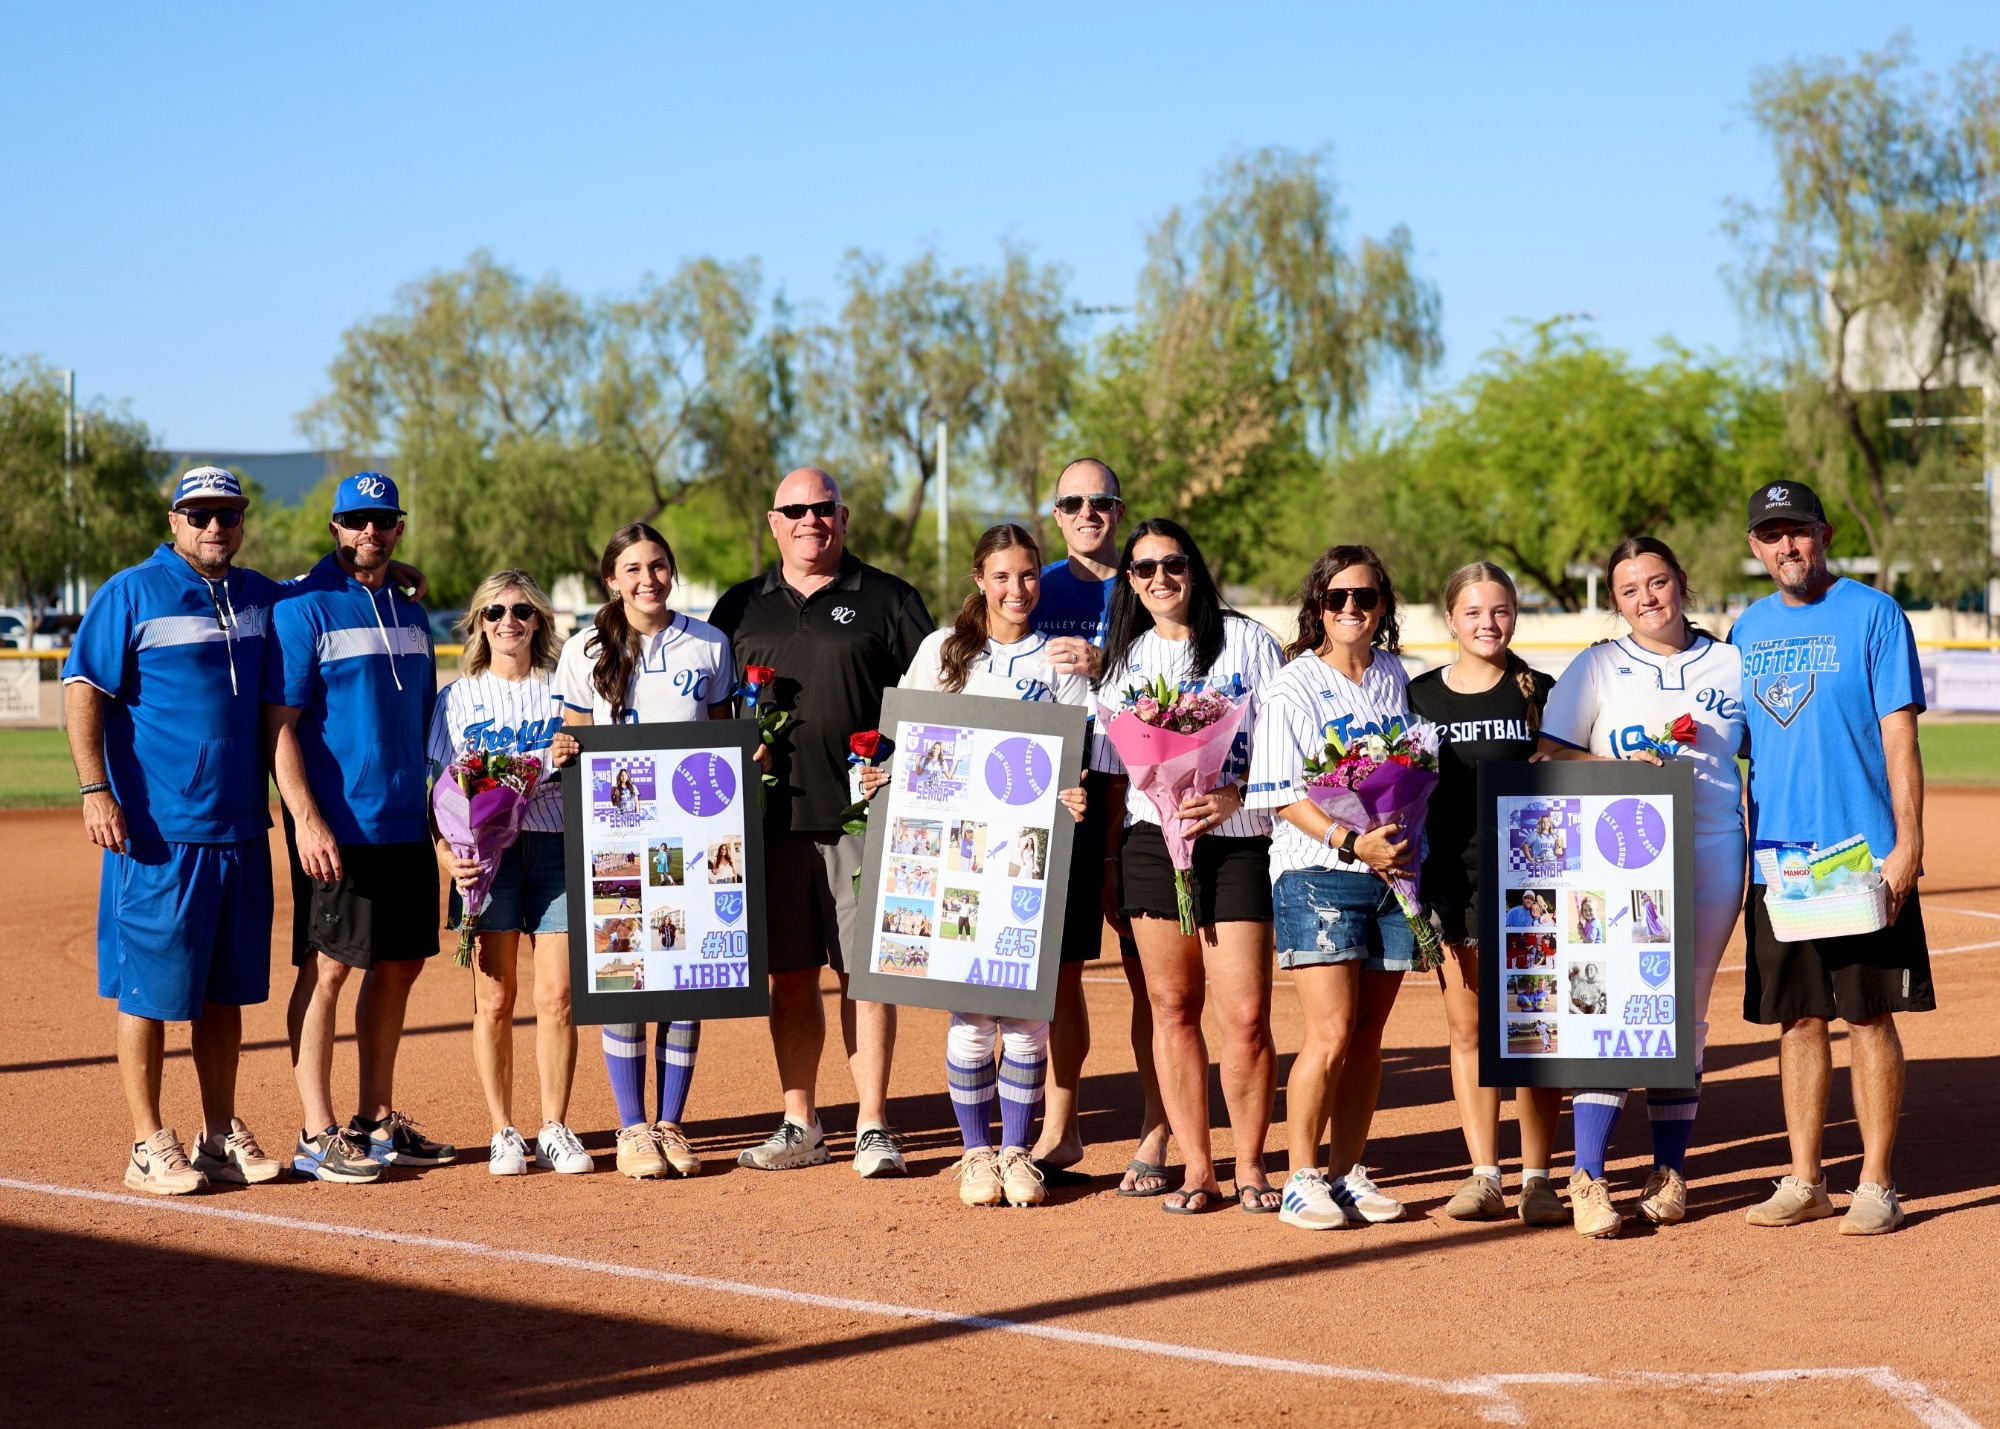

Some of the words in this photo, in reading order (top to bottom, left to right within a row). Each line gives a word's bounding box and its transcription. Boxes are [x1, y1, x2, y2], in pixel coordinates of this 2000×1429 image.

[357, 477, 385, 498] VC
[1765, 501, 1791, 509] SOFTBALL
[831, 606, 856, 624] VC
[1038, 621, 1076, 629] VALLEY
[1752, 640, 1784, 652] VALLEY
[1784, 635, 1835, 647] CHRISTIAN
[1743, 646, 1840, 680] SOFTBALL
[673, 669, 709, 701] VC
[1696, 688, 1737, 719] VC
[1450, 719, 1532, 743] SOFTBALL
[991, 748, 1006, 762] ADDI
[1025, 740, 1036, 764] CLASS
[677, 765, 697, 787] LIBBY
[709, 753, 718, 777] CLASS
[1025, 767, 1033, 776] OF
[710, 779, 719, 788] OF
[917, 785, 949, 802] SENIOR
[610, 814, 641, 828] SENIOR
[1636, 800, 1646, 826] CLASS
[1601, 810, 1619, 831] TAYA
[1616, 831, 1626, 868] CLAUSEN
[1638, 828, 1647, 837] OF
[1528, 862, 1562, 878] SENIOR
[1783, 869, 1810, 877] MANGO
[717, 894, 742, 915] VC
[1014, 890, 1040, 912] VC
[701, 930, 748, 959] #10
[995, 927, 1037, 959] #5
[674, 962, 748, 990] LIBBY
[965, 958, 1030, 990] ADDI
[1641, 955, 1670, 977] VC
[1623, 995, 1675, 1025] #19
[1593, 1030, 1675, 1057] TAYA
